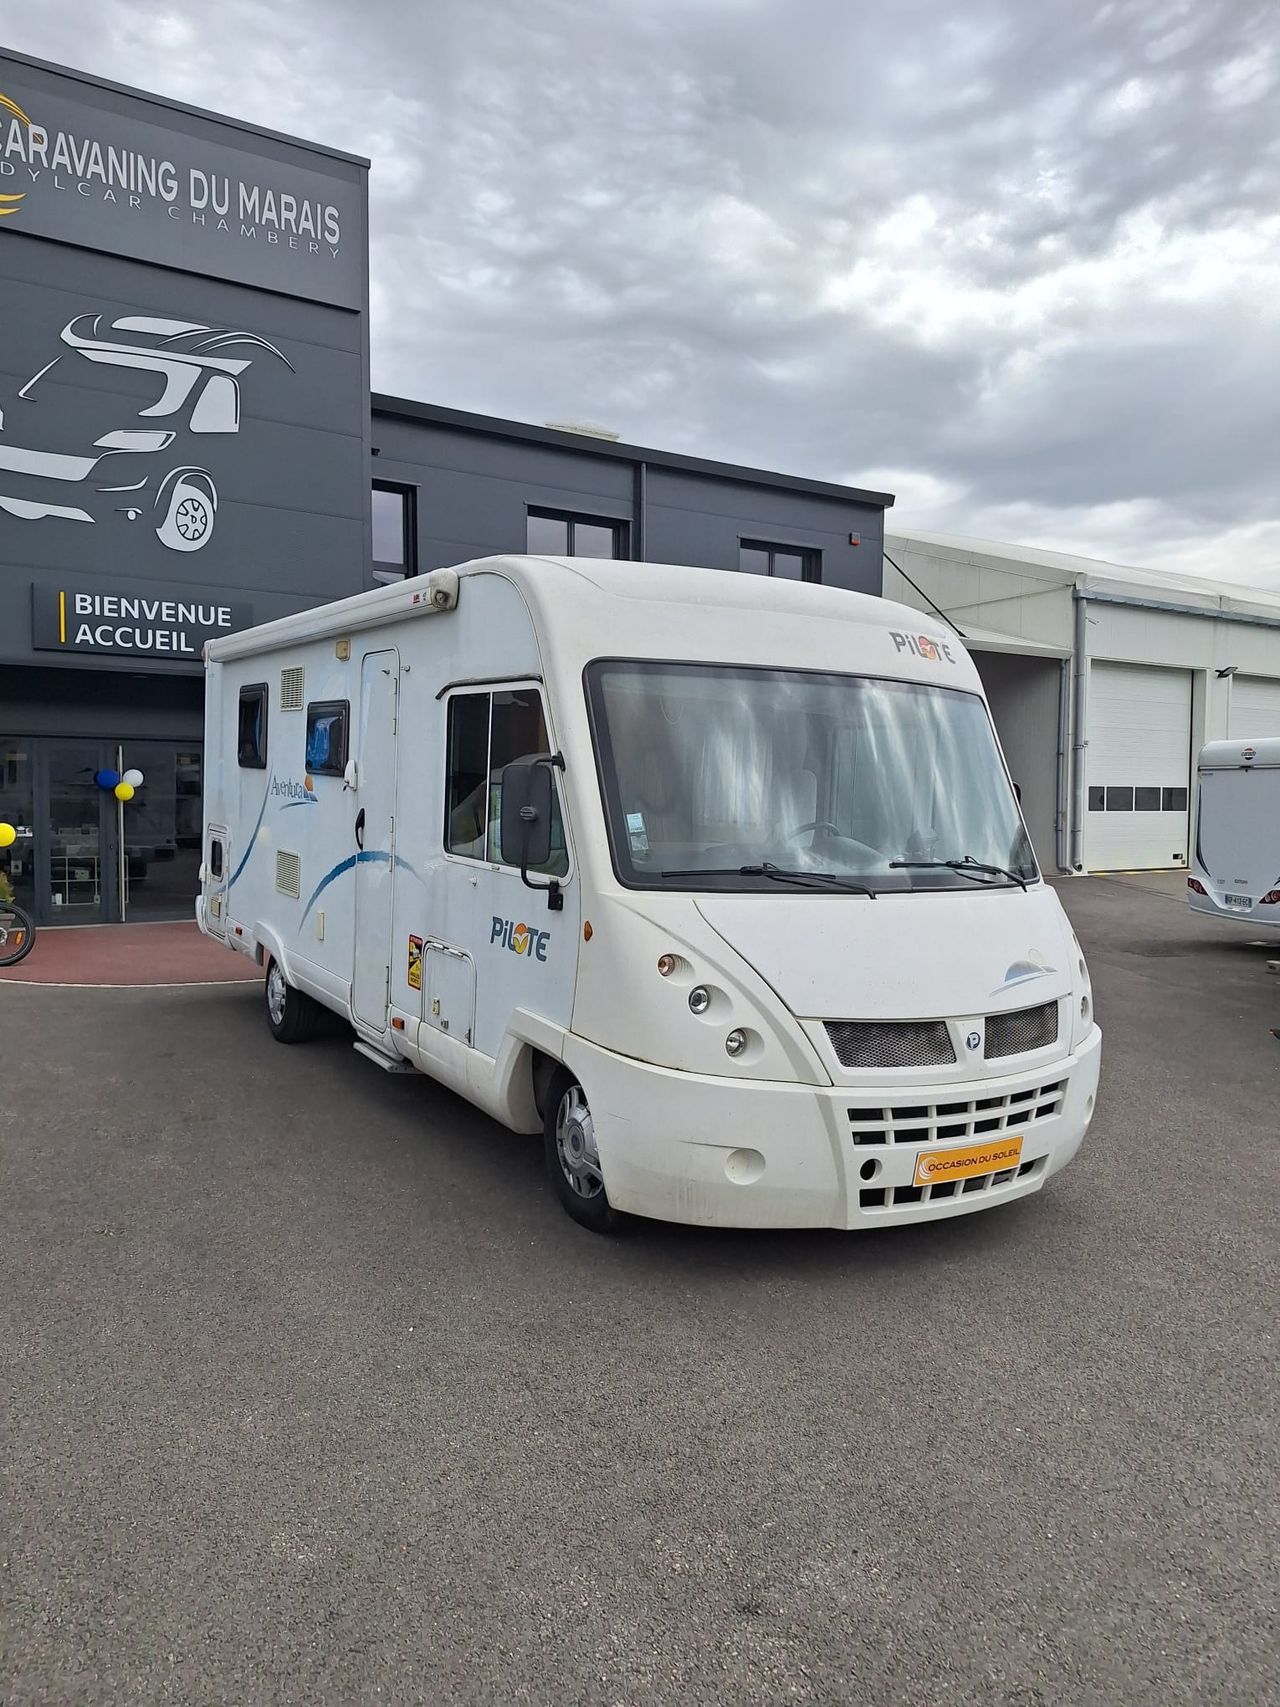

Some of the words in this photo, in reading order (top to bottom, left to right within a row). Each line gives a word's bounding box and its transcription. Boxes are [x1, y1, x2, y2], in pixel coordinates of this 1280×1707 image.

[0, 119, 178, 202] ARAVANING
[190, 168, 229, 215] DU
[239, 182, 340, 245] MARAIS
[168, 206, 339, 260] CHAMBERY
[74, 593, 232, 627] BIENVENUE
[74, 624, 195, 652] ACCUEIL
[928, 1157, 977, 1172] OCCASION
[978, 1154, 991, 1164] DU
[992, 1148, 1020, 1160] SOLEIL
